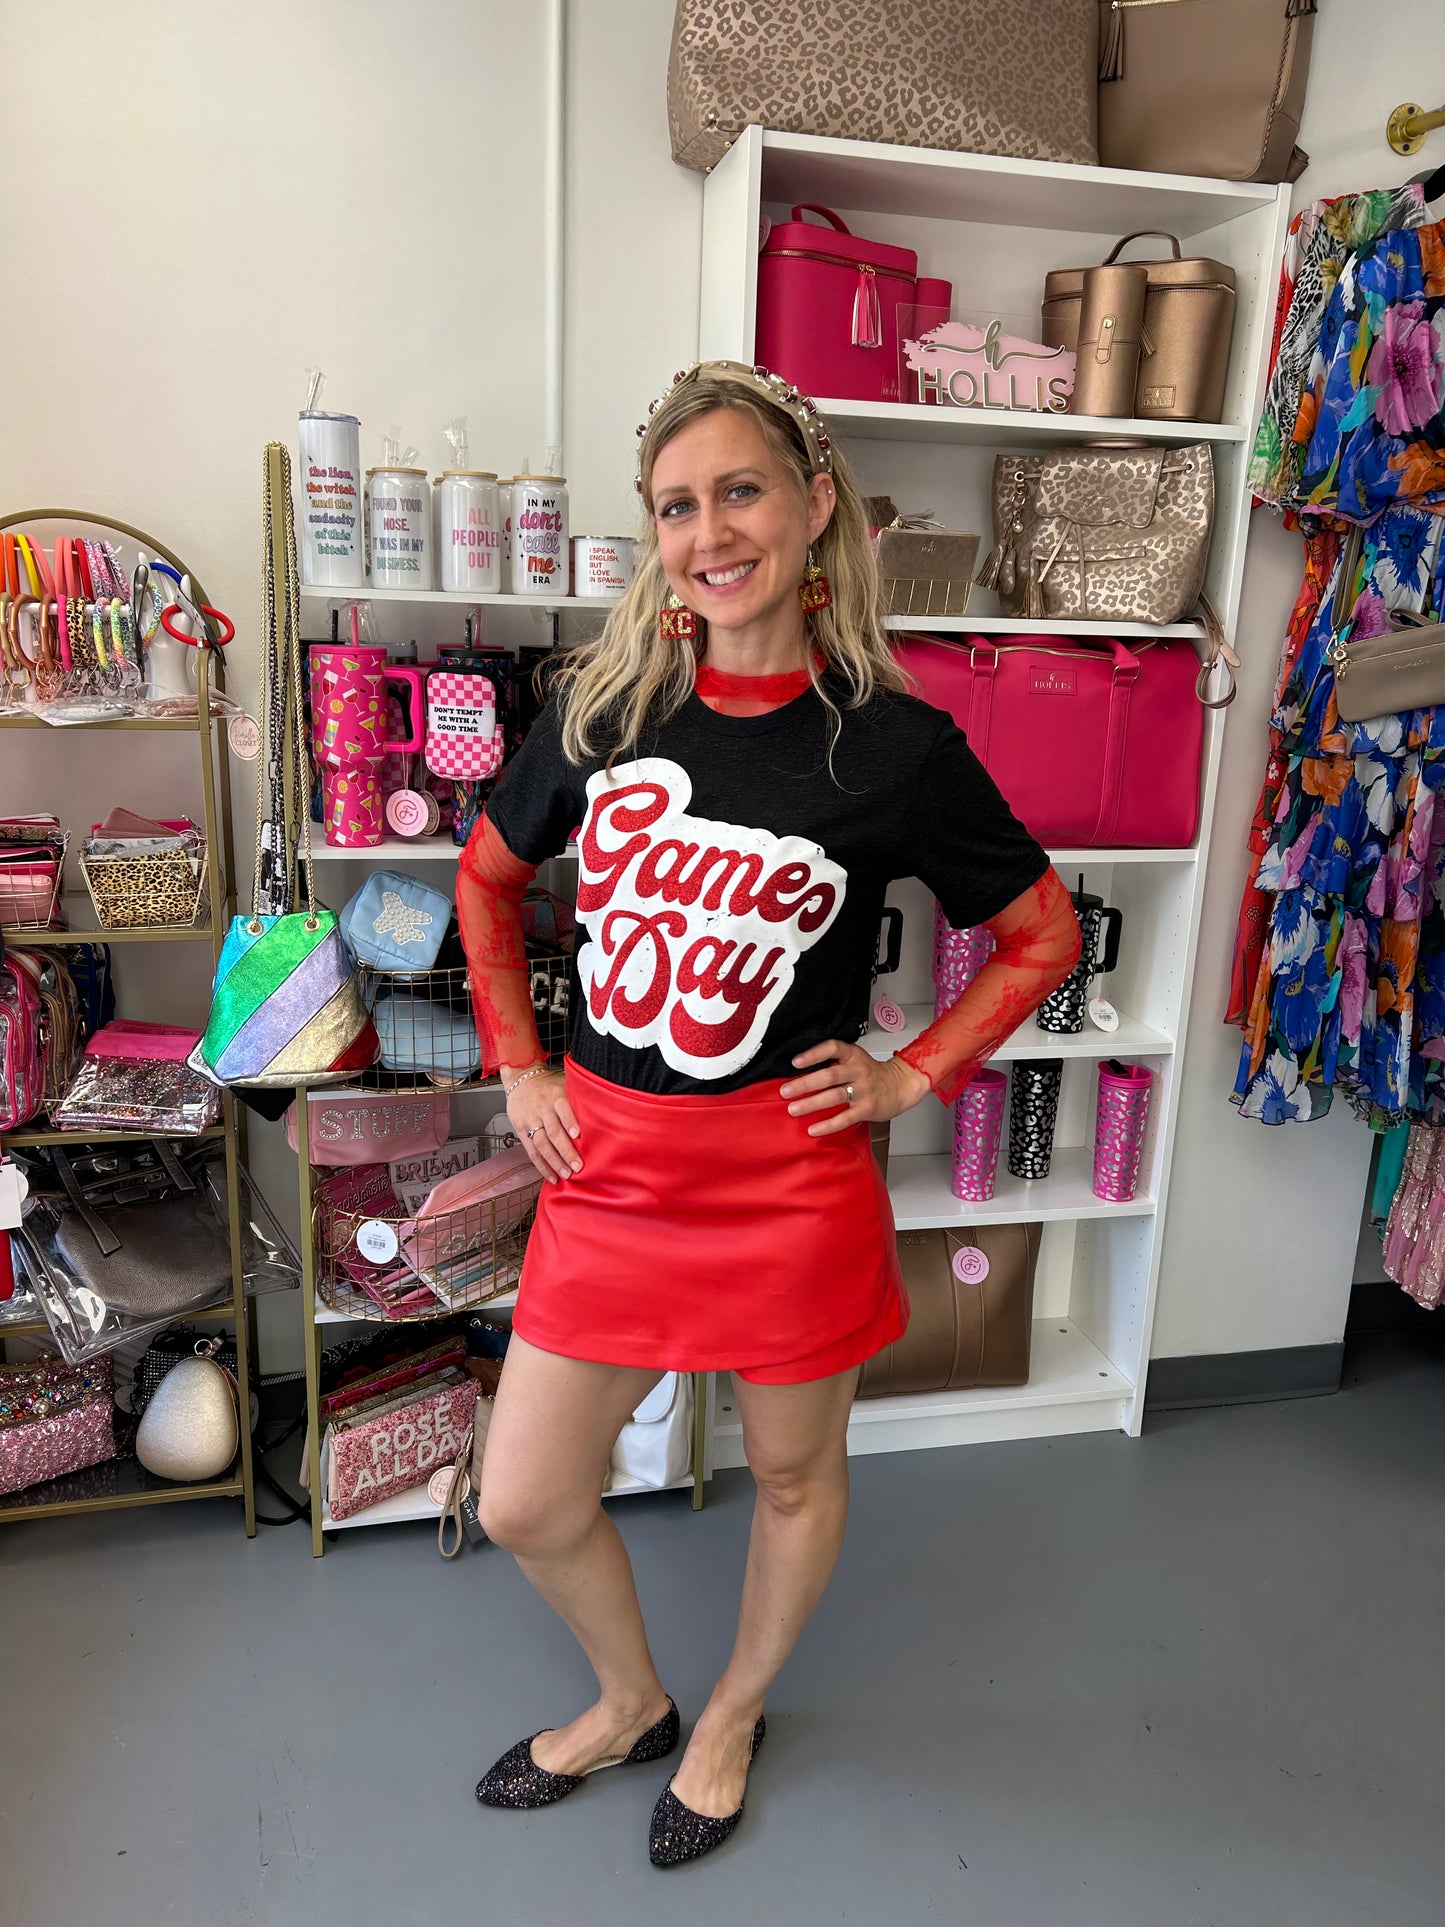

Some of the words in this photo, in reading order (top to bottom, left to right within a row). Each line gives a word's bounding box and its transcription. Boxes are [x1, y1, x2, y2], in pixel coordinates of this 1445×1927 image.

[917, 365, 1070, 414] HOLLIS
[309, 466, 327, 478] the
[306, 482, 323, 494] the
[311, 498, 333, 509] and
[334, 499, 353, 510] the
[372, 498, 397, 511] FOUND
[400, 498, 423, 512] YOUR
[527, 498, 538, 507] IN
[542, 499, 556, 508] MY
[308, 512, 356, 528] audacity
[383, 517, 410, 531] NOSE.
[468, 508, 490, 525] ALL
[520, 509, 563, 532] don't
[314, 528, 327, 540] of
[328, 529, 351, 541] this
[317, 543, 349, 556] bitch
[379, 537, 397, 551] WAS
[400, 538, 410, 552] IN
[411, 538, 424, 552] MY
[523, 532, 561, 554] call
[376, 556, 420, 571] BUSINESS.
[468, 551, 491, 568] OUT
[527, 555, 556, 574] me
[533, 576, 550, 584] ERA
[661, 612, 692, 635] KC
[433, 706, 455, 714] DON'T
[456, 708, 483, 716] TEMPT
[449, 716, 470, 724] WITH
[437, 723, 457, 731] GOOD
[458, 725, 479, 733] TIME
[577, 782, 836, 933] Game
[589, 909, 786, 1058] Day
[319, 1102, 433, 1141] STUFF
[395, 1151, 476, 1184] BRIDAL
[352, 1454, 411, 1498] ALL
[417, 1424, 472, 1468] DAY
